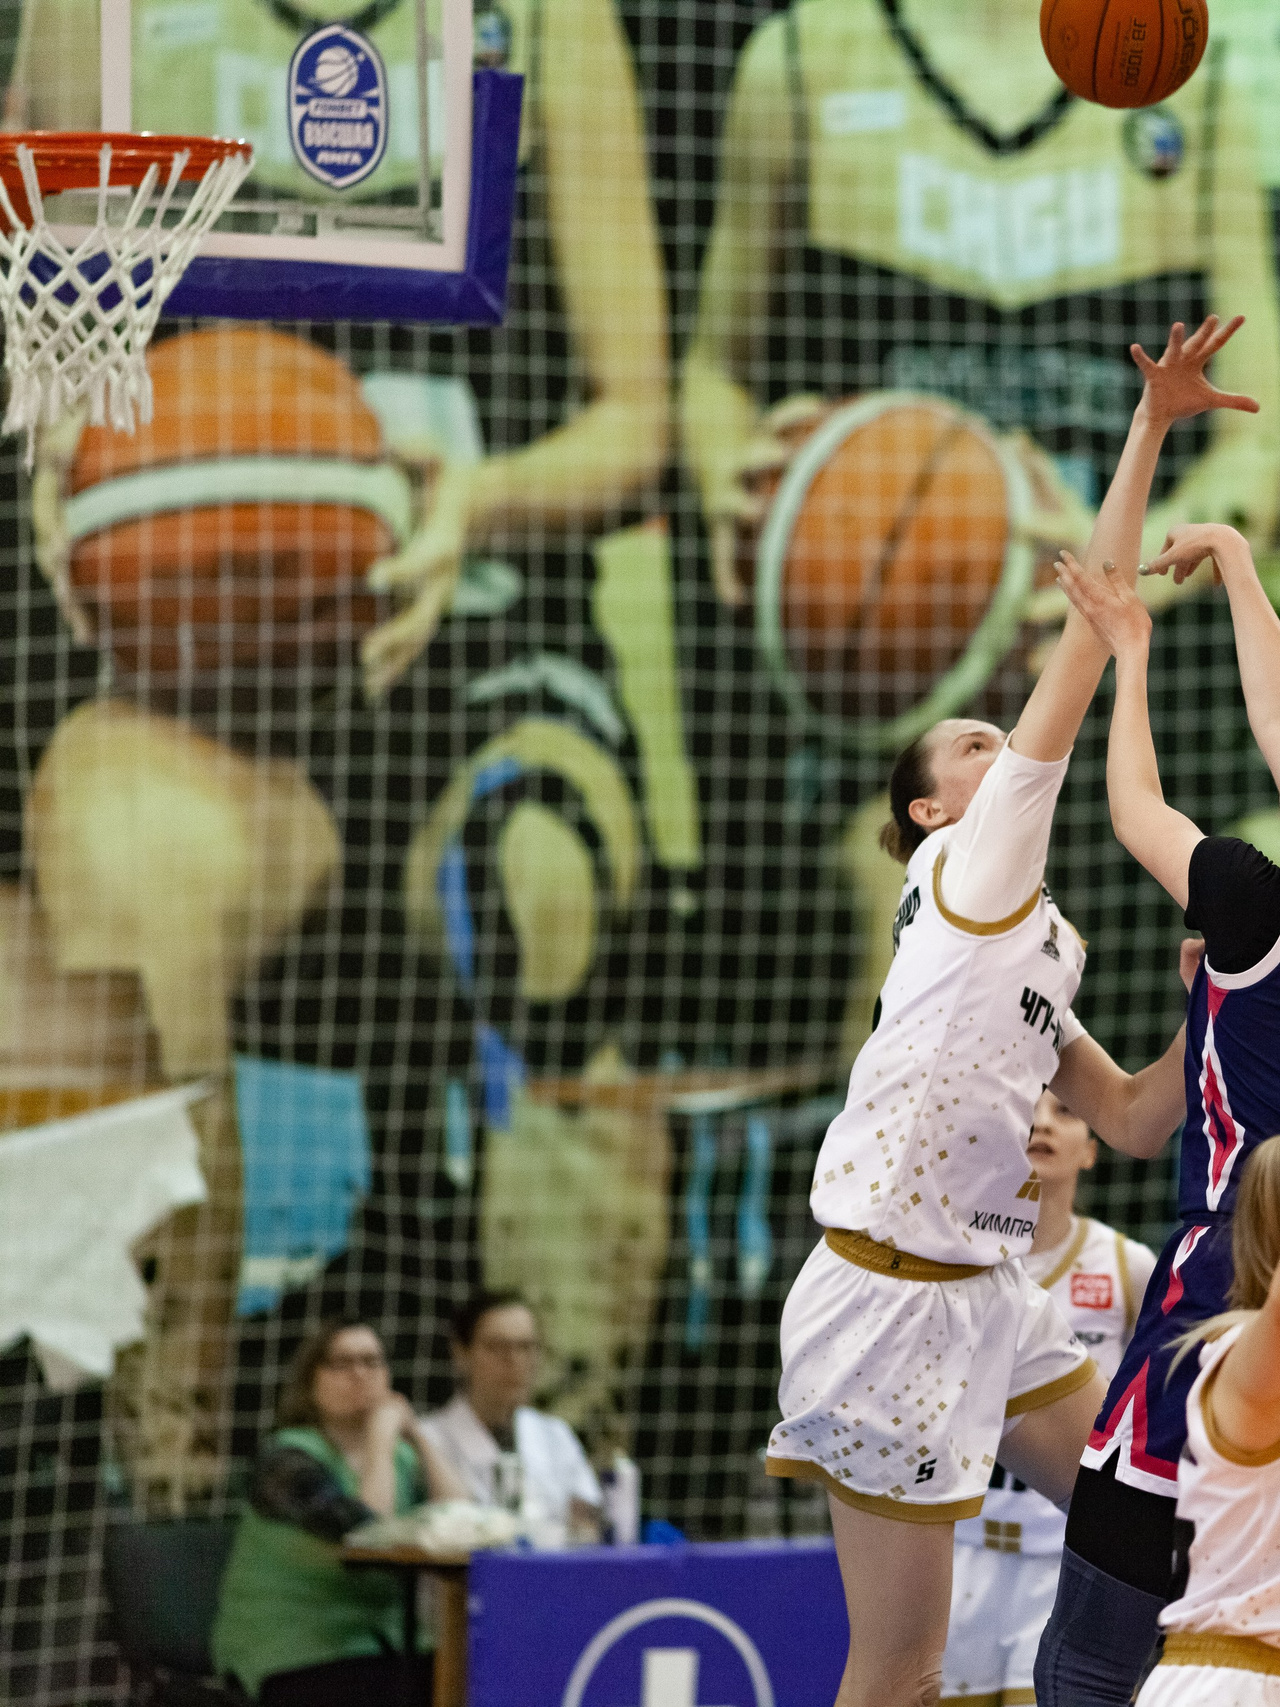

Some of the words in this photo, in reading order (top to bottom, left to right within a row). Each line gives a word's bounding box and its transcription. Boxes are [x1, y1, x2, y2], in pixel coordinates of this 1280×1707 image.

[1132, 17, 1146, 41] JB
[1020, 985, 1064, 1057] ЧГУ-
[969, 1210, 1037, 1239] ХИМПР
